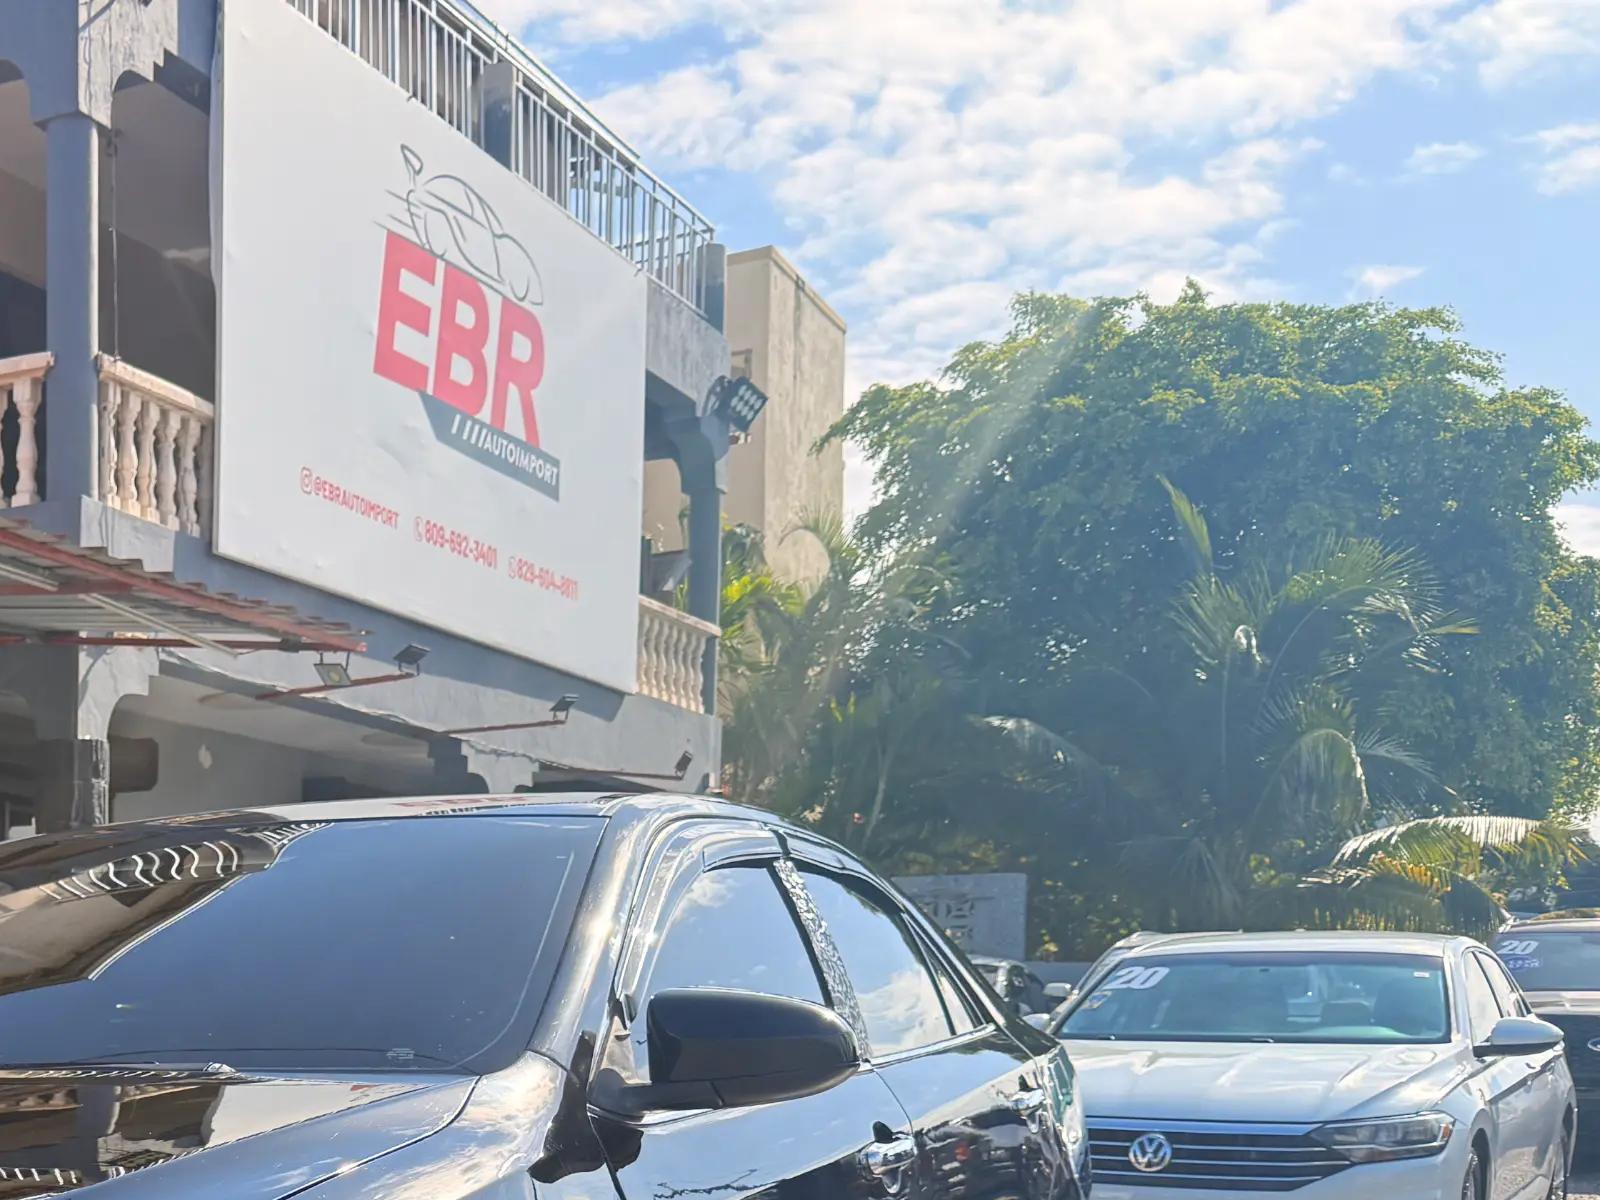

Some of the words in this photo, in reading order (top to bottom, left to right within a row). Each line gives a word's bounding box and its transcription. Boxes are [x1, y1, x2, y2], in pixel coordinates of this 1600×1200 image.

[373, 229, 545, 448] EBR
[482, 432, 558, 486] AUTOIMPORT
[1496, 939, 1540, 955] 20
[1102, 966, 1171, 990] 20
